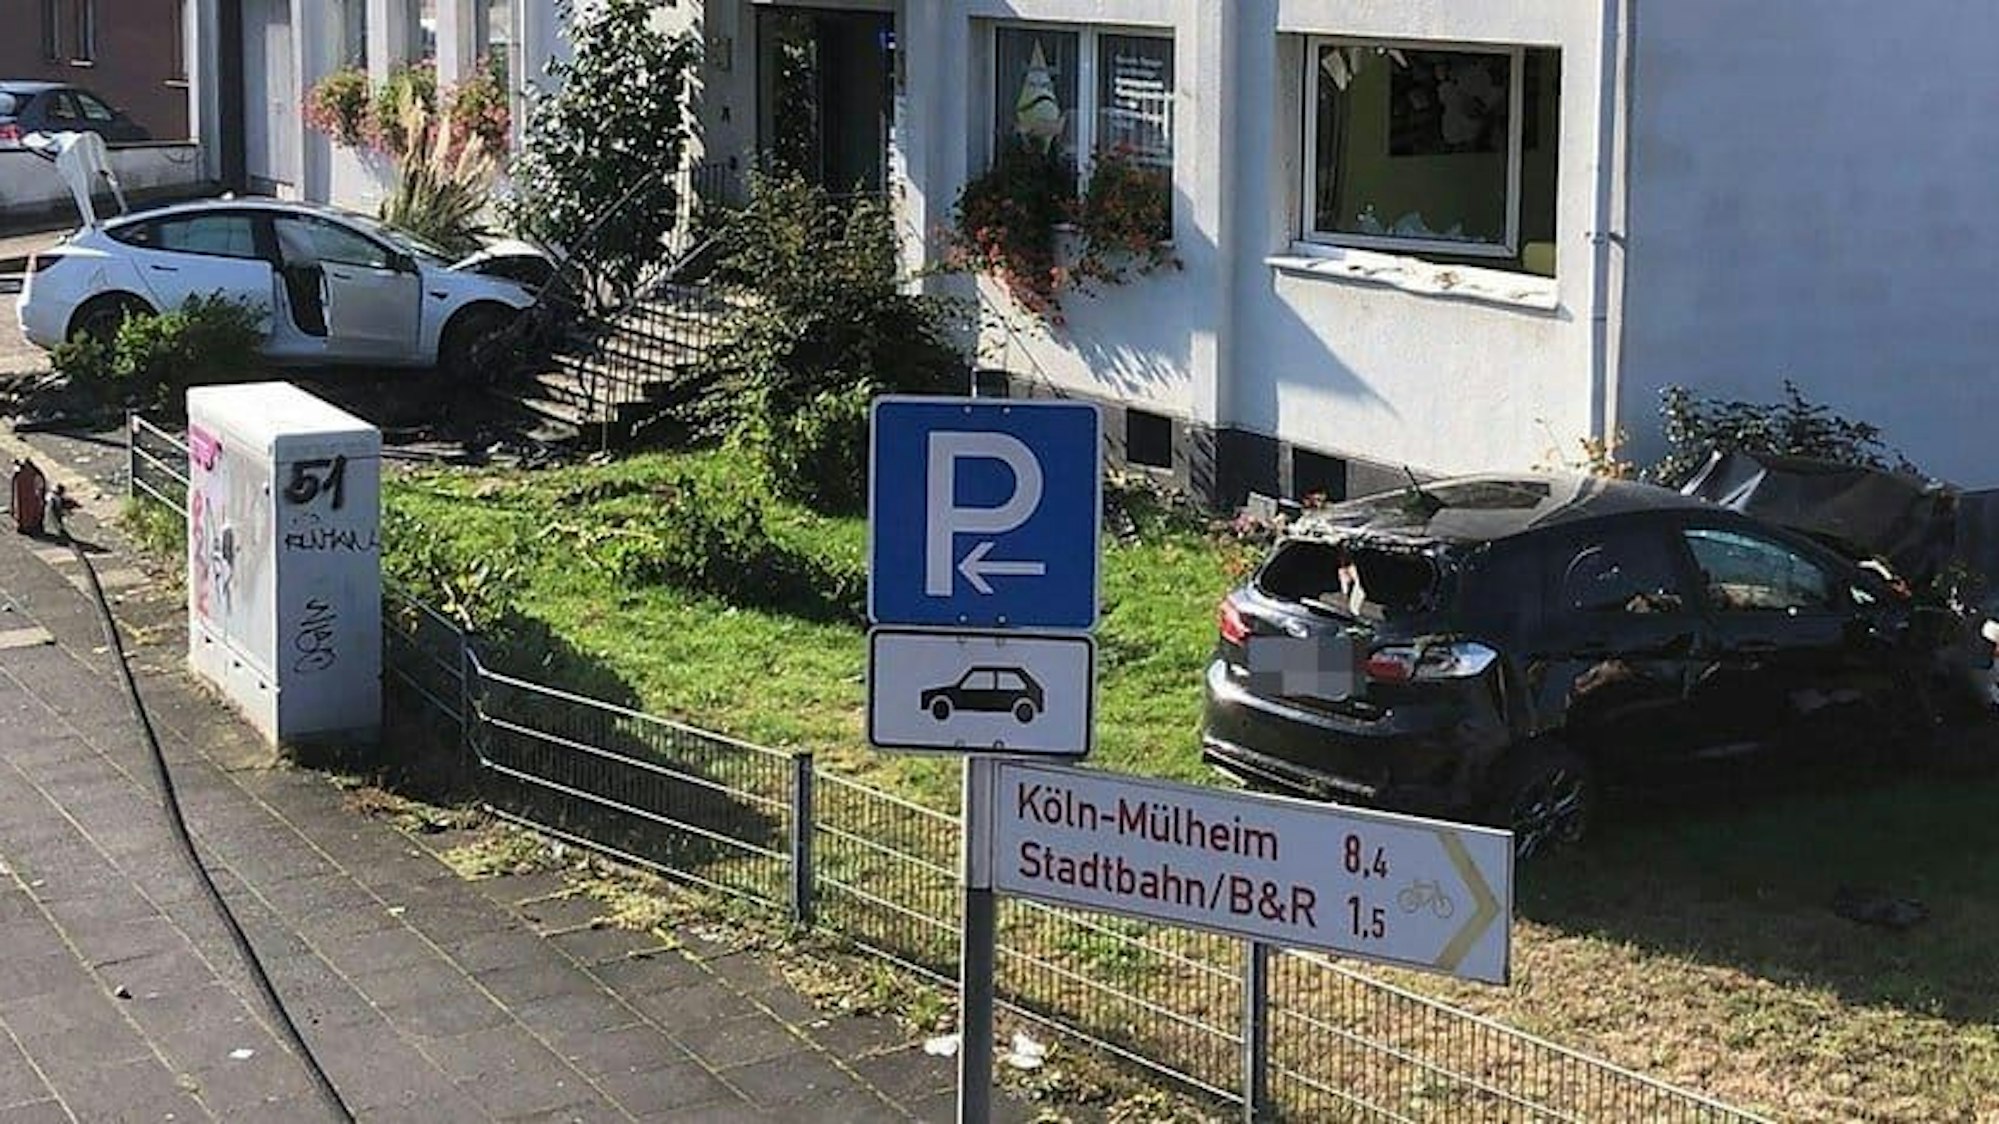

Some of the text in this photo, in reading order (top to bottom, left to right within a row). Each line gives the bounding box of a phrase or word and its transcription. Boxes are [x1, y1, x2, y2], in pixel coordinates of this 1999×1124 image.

[285, 454, 346, 511] 51
[926, 431, 1043, 596] P
[1017, 782, 1388, 879] Köln-Mülheim 8,4
[1018, 841, 1385, 939] Stadtbahn/B&R 1,5
